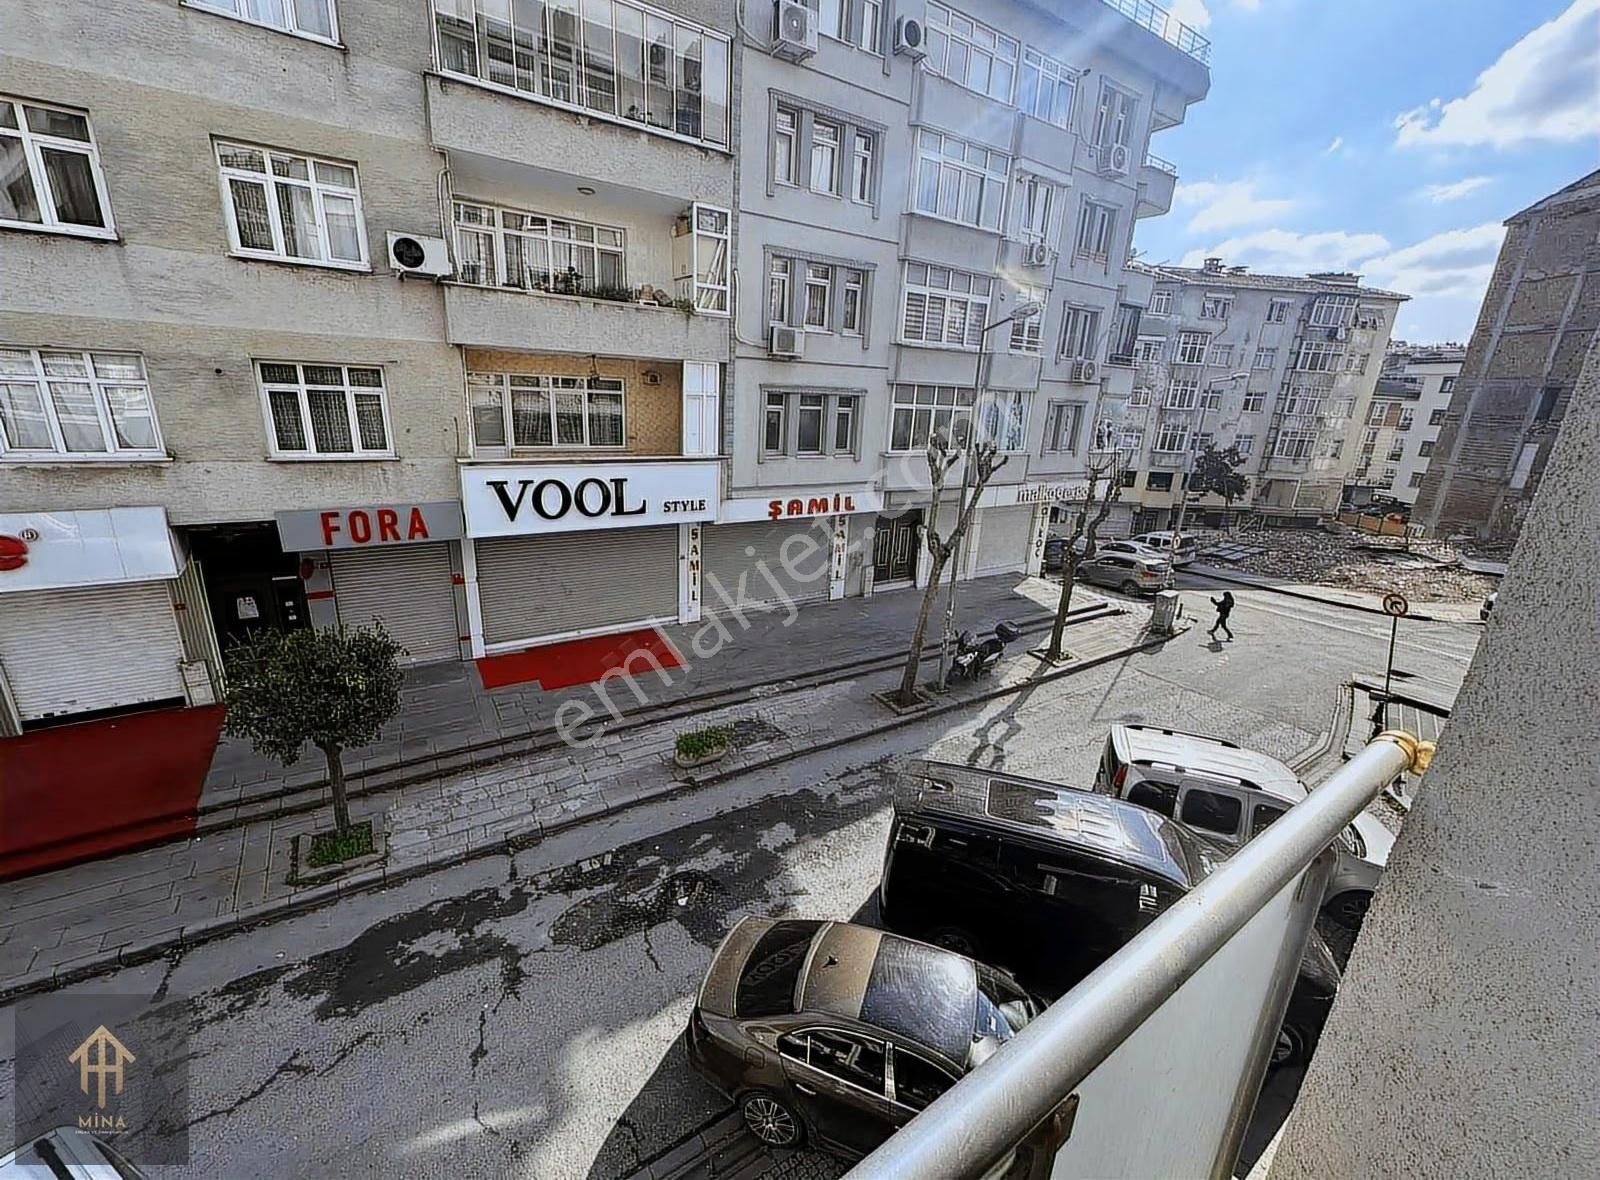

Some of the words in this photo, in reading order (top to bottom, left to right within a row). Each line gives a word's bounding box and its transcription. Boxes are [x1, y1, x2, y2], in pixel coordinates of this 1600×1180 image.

[486, 478, 647, 522] VOOL
[663, 500, 707, 513] STYLE
[768, 493, 855, 521] ŞAMİL
[320, 507, 429, 546] FORA
